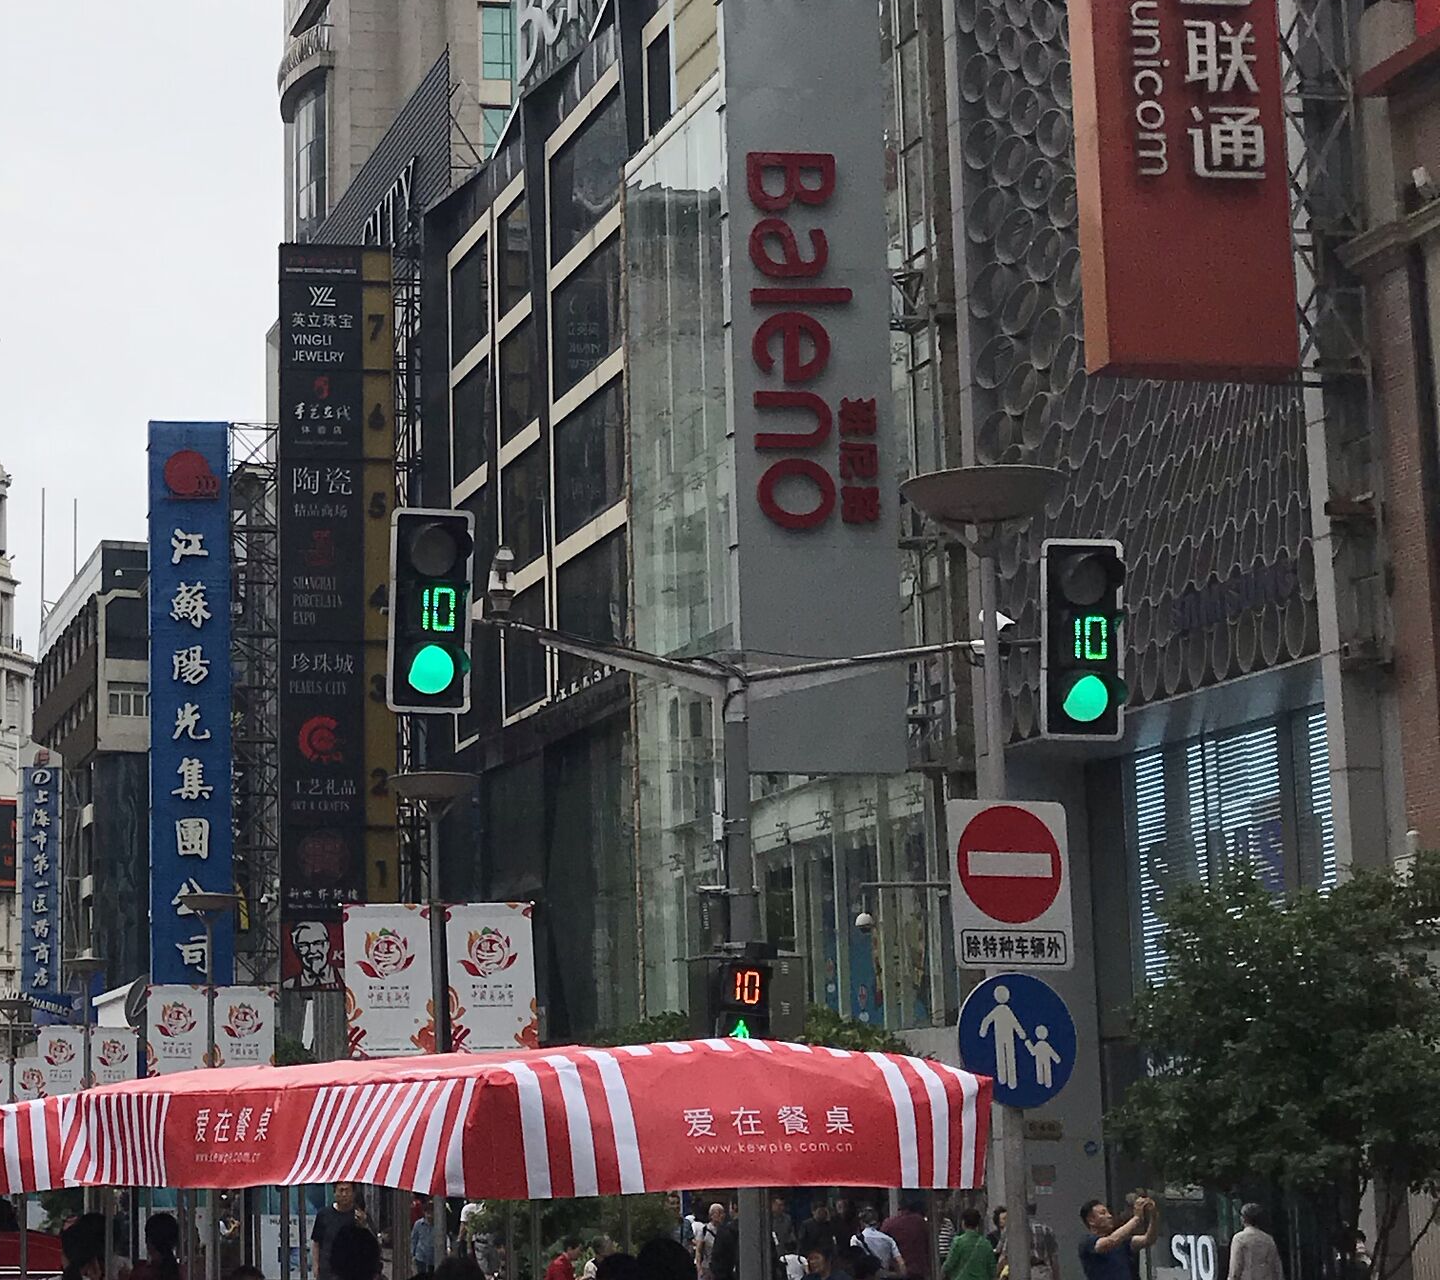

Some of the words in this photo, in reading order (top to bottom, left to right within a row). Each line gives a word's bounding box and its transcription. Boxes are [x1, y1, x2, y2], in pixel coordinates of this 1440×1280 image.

[1131, 1, 1172, 177] unicom
[292, 312, 353, 329] 英立珠宝
[367, 314, 385, 342] 7
[292, 334, 332, 346] YINGLI
[746, 151, 853, 530] Baleno
[292, 351, 344, 362] JEWELRY
[292, 467, 353, 495] 陶瓷
[292, 576, 336, 591] SHANGHAI
[292, 593, 343, 607] PORCELAIN
[421, 586, 456, 632] 10
[292, 612, 315, 625] EXPO
[1074, 615, 1108, 661] 10
[290, 653, 354, 675] 珍珠城
[289, 680, 321, 696] PEARLS
[169, 528, 213, 974] 江蘇陽光集團公司
[293, 779, 356, 796] 工艺礼品
[30, 789, 51, 987] 上海市第一医药商店
[965, 936, 1062, 960] 除特种车辆外
[735, 971, 760, 1005] 10
[195, 1107, 272, 1143] 爱在餐桌
[683, 1105, 855, 1138] 爱在餐桌
[695, 1141, 853, 1155] www.kewpie.com.cn
